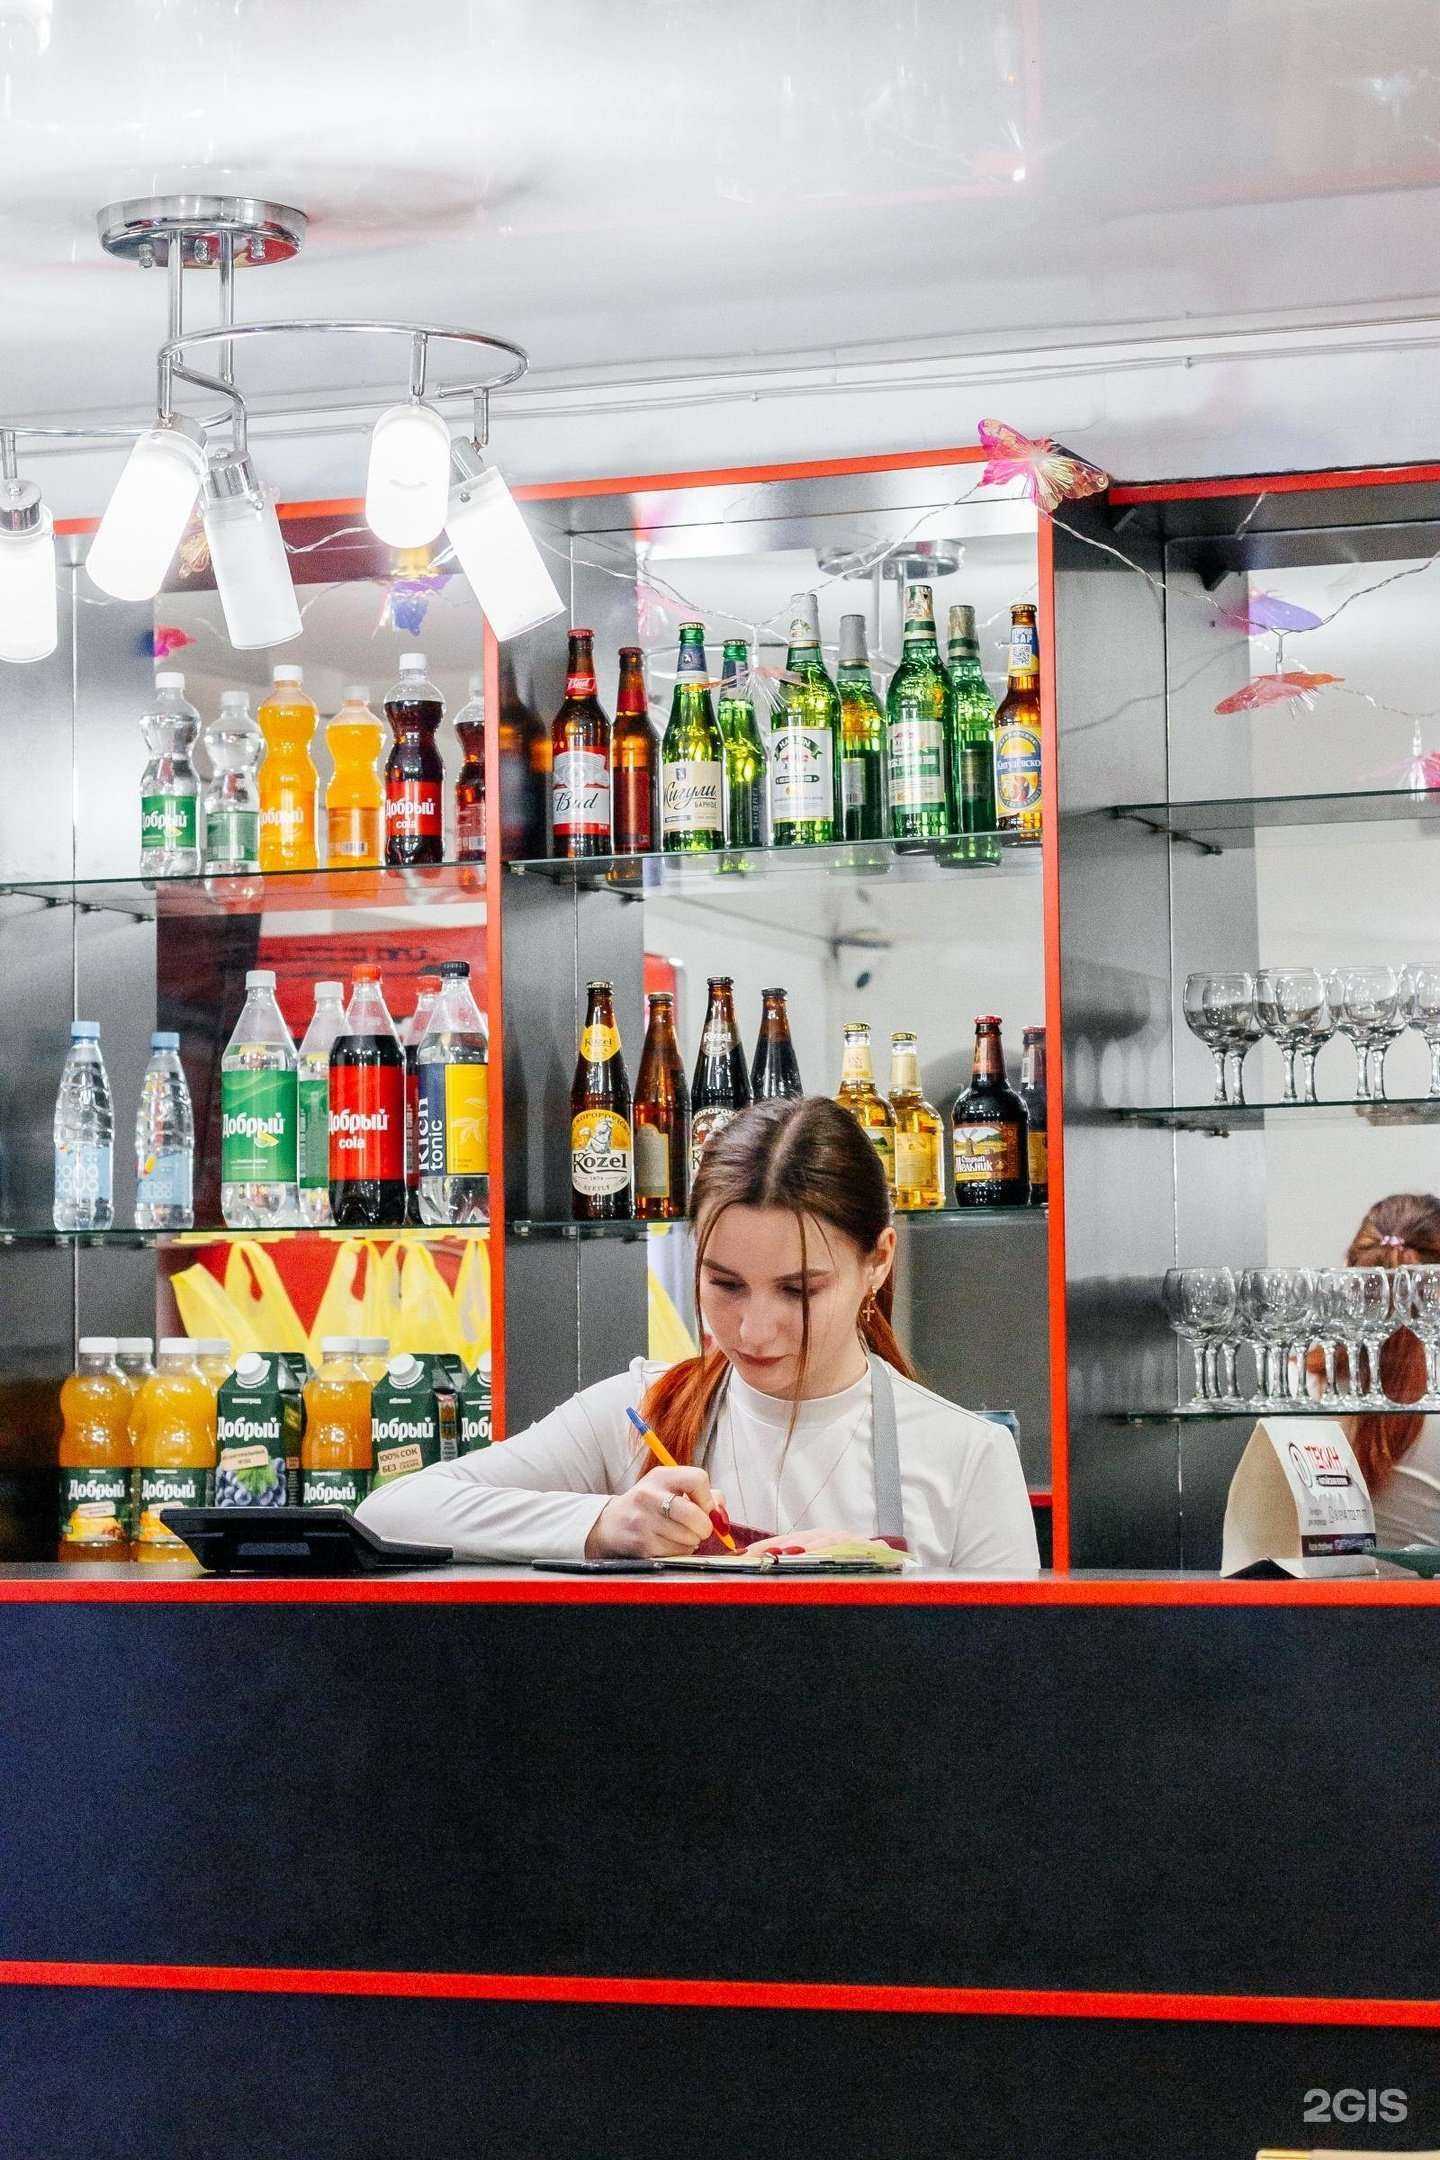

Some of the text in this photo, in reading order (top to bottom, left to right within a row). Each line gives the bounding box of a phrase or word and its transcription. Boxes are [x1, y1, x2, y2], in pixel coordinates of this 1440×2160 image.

[554, 792, 599, 812] Bud
[222, 1112, 285, 1138] Добрый
[339, 1136, 365, 1149] cola
[431, 1120, 443, 1170] tonic
[571, 1153, 627, 1173] Kozel
[217, 1417, 280, 1441] Добрый
[371, 1417, 434, 1442] Добрый
[462, 1416, 492, 1442] Доб
[400, 1448, 418, 1458] СОК
[68, 1479, 126, 1500] Добрый
[142, 1479, 196, 1500] Добрый
[304, 1481, 356, 1503] Добрый
